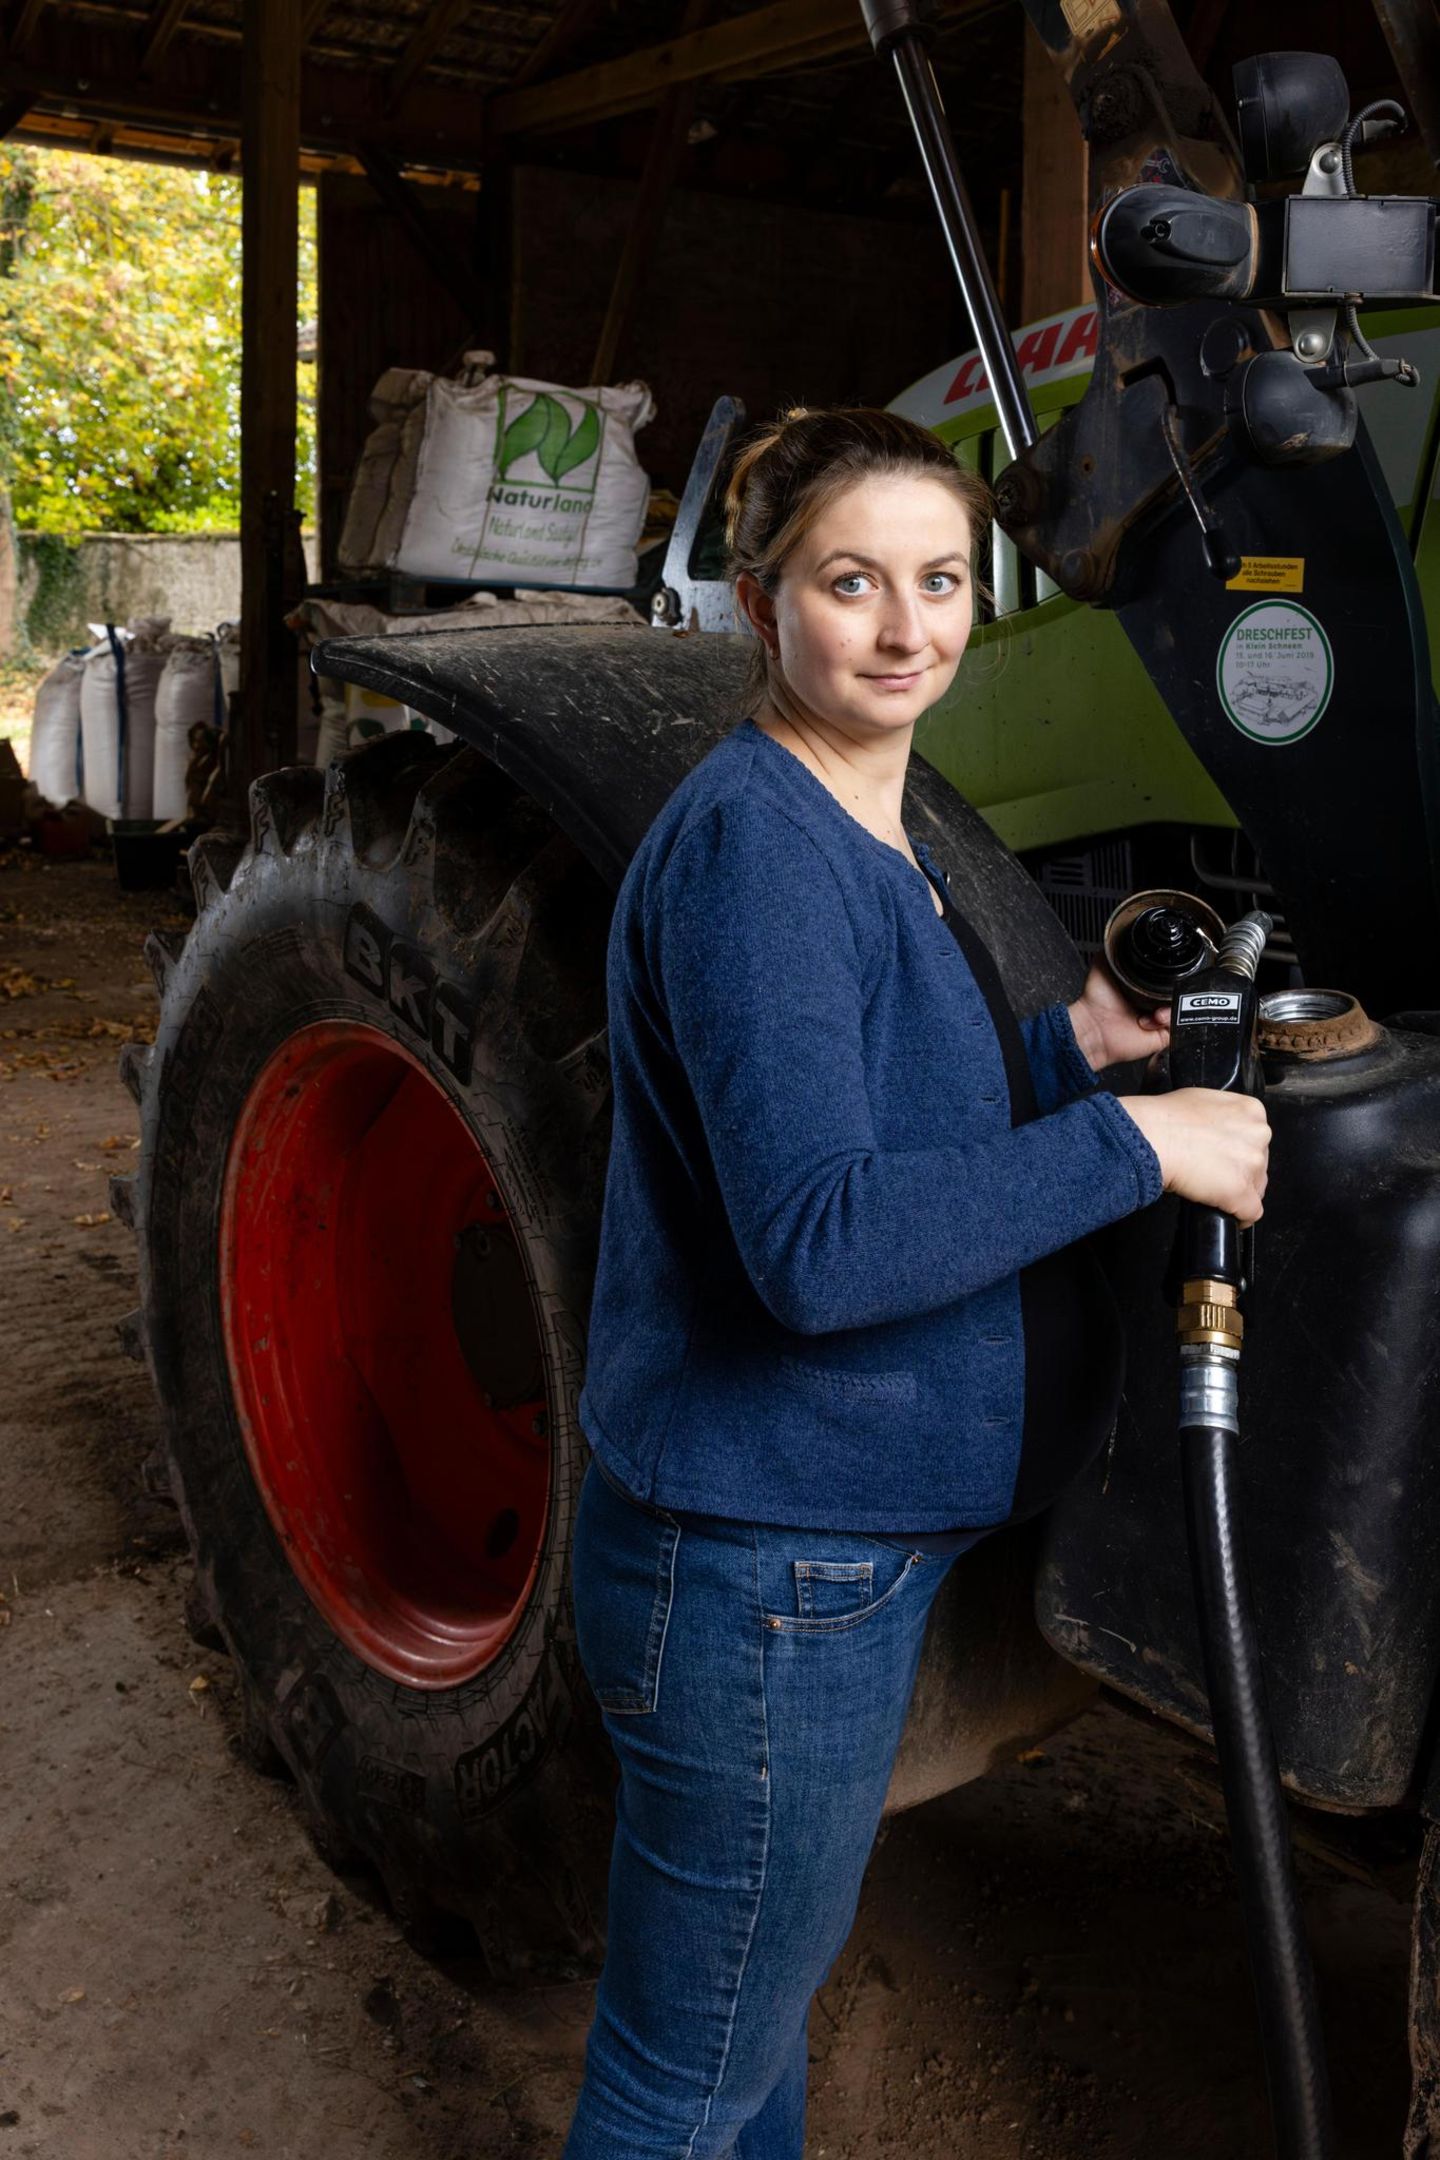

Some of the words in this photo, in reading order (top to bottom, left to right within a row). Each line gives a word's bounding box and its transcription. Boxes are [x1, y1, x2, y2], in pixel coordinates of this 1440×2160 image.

[486, 485, 593, 513] Naturland
[1237, 628, 1312, 641] DRESCHFEST
[1248, 652, 1262, 660] und
[347, 921, 471, 1065] BKT
[1191, 998, 1228, 1006] CEMO
